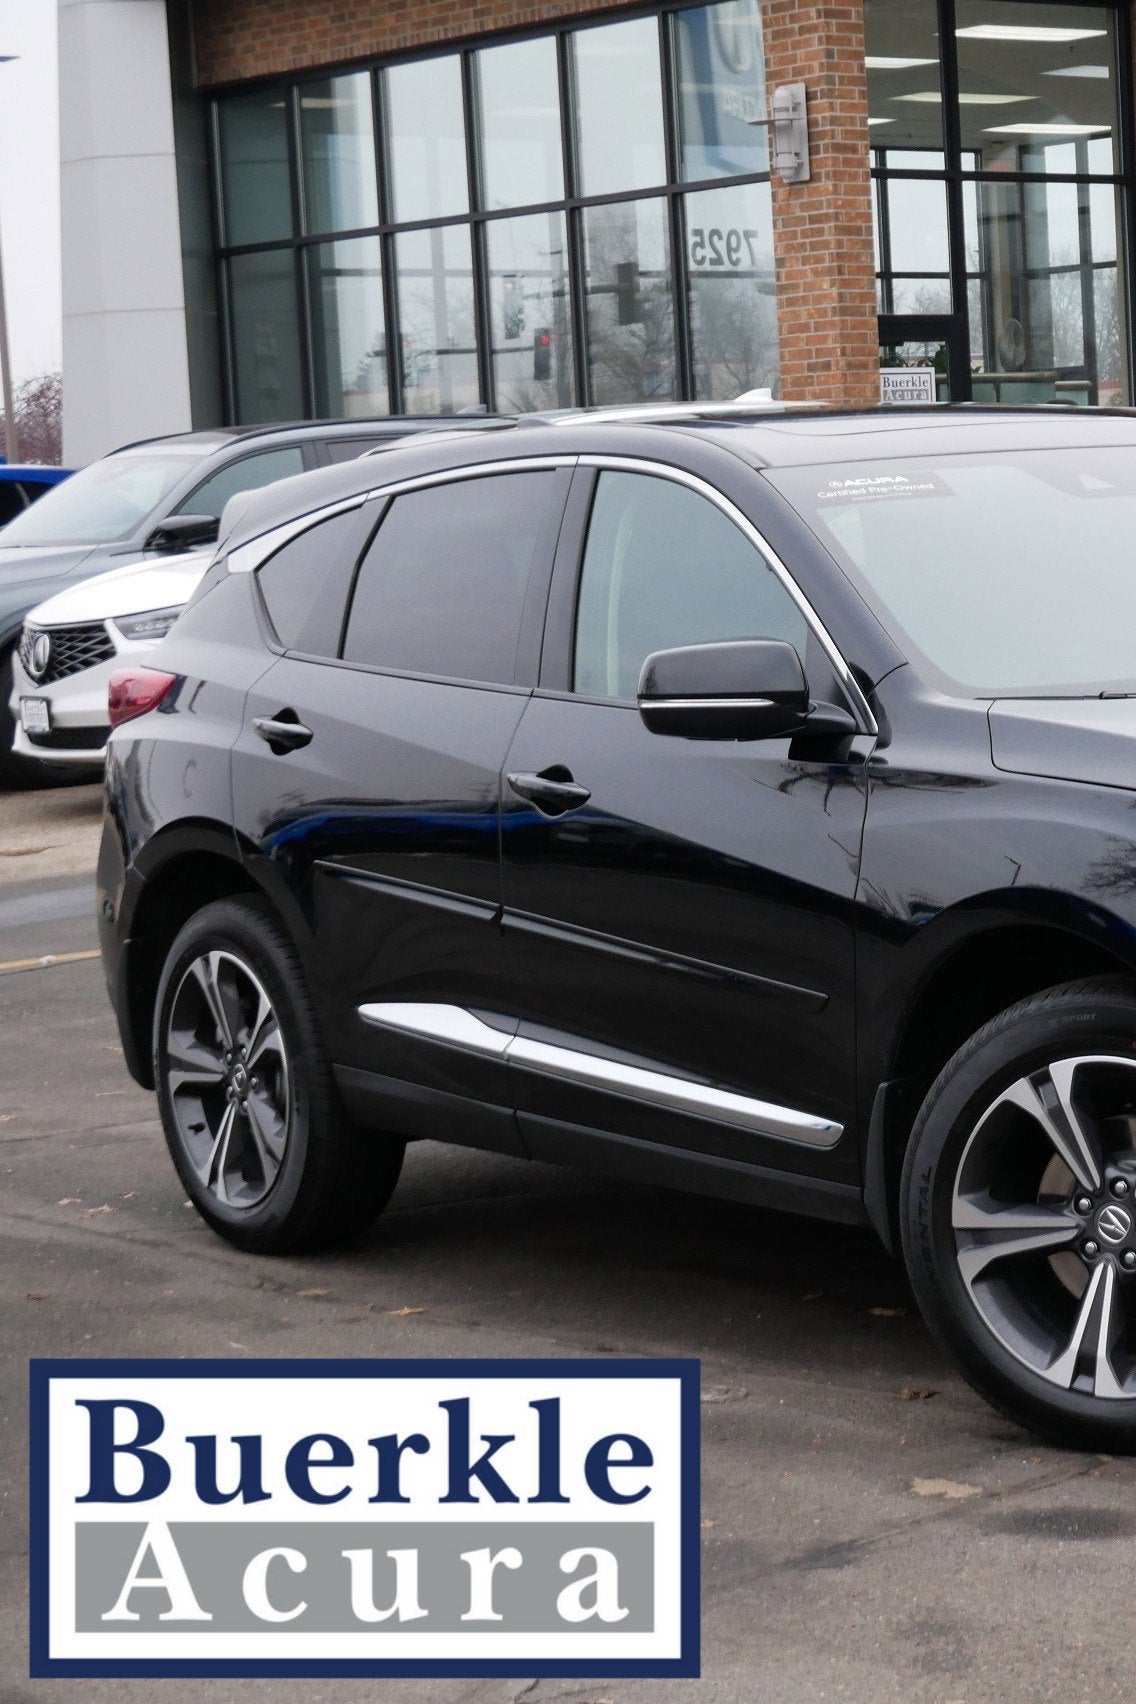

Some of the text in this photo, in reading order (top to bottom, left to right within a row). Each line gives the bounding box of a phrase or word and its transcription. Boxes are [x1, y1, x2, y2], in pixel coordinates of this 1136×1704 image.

[883, 376, 929, 388] Buerkle
[885, 389, 928, 400] Acura
[844, 475, 909, 487] ACURA
[817, 486, 867, 499] Certified
[868, 482, 935, 494] Pre-Owned
